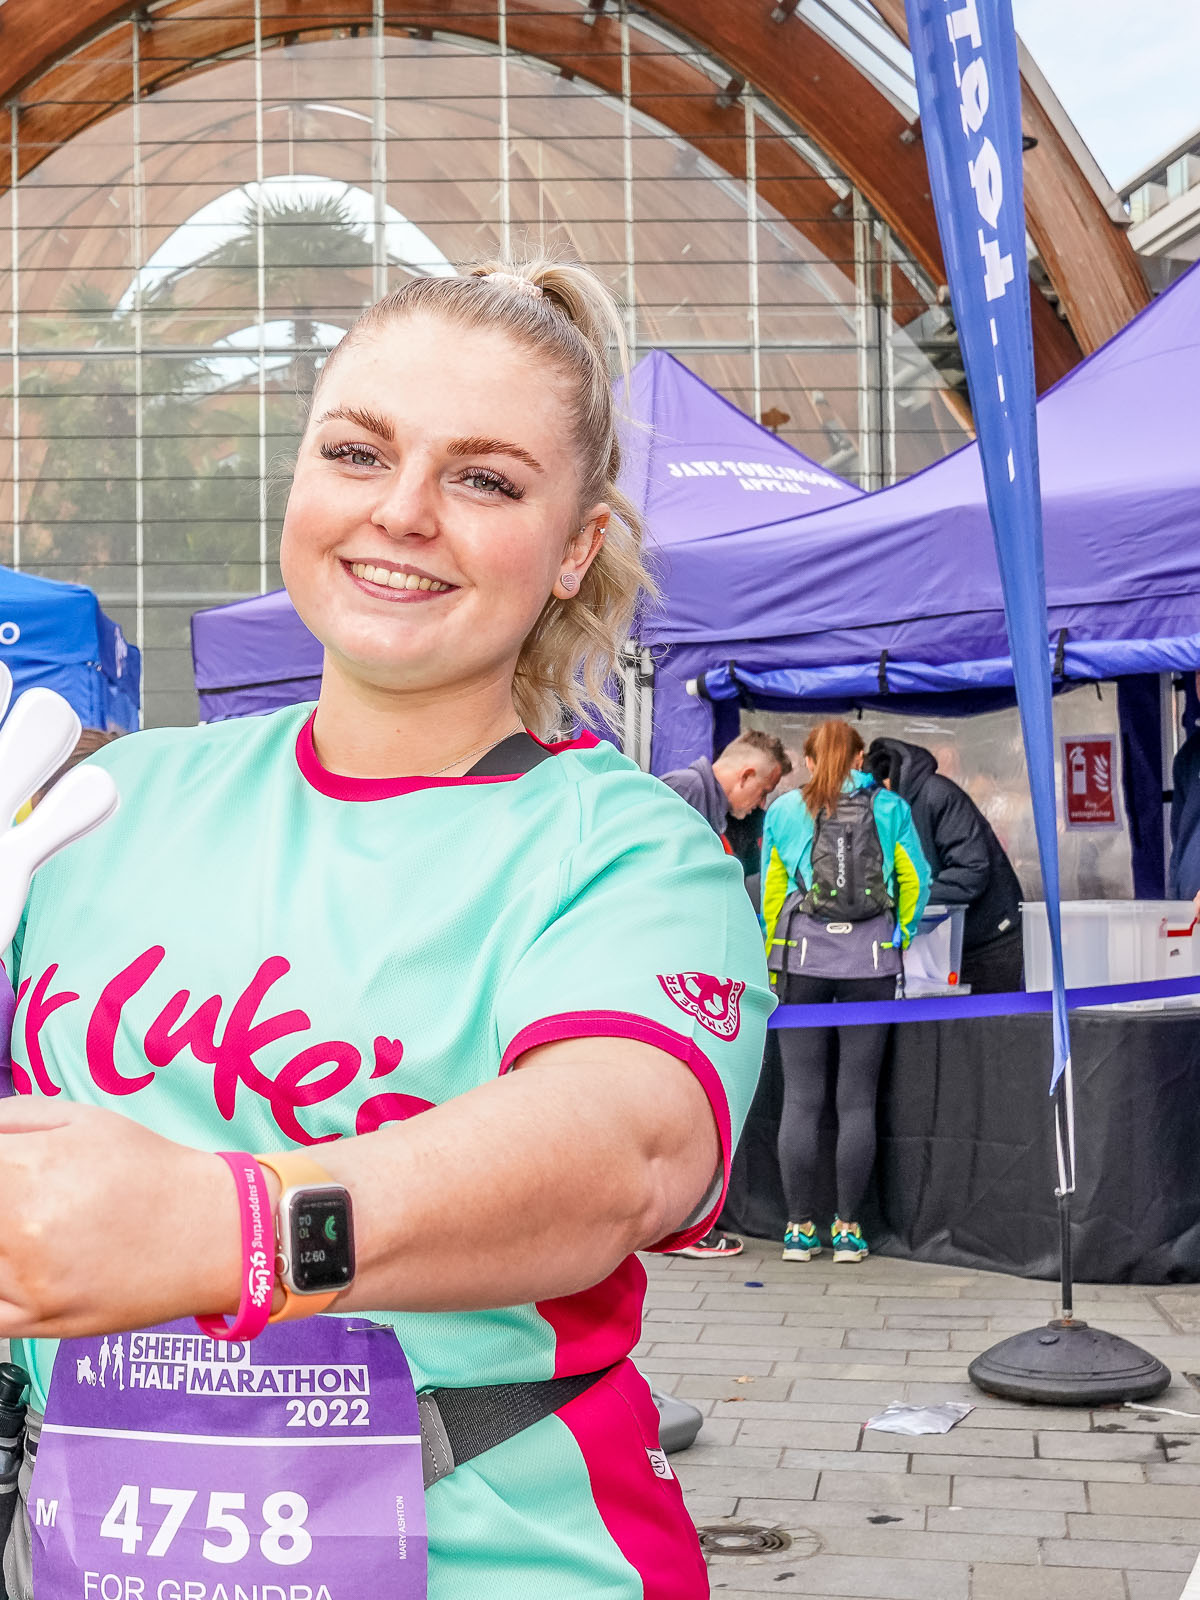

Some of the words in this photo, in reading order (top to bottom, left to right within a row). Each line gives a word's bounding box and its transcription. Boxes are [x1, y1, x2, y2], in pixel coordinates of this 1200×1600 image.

[244, 1167, 255, 1183] I'm
[248, 1184, 265, 1249] supporting
[131, 1335, 247, 1363] SHEFFIELD
[130, 1364, 186, 1391] HALF
[190, 1367, 367, 1394] MARATHON
[285, 1398, 371, 1428] 2022
[35, 1498, 58, 1528] M
[100, 1484, 313, 1566] 4758
[395, 1495, 407, 1533] ASHTON
[398, 1534, 407, 1560] MARY
[84, 1571, 145, 1600] FOR
[157, 1579, 333, 1600] GRANDPA
